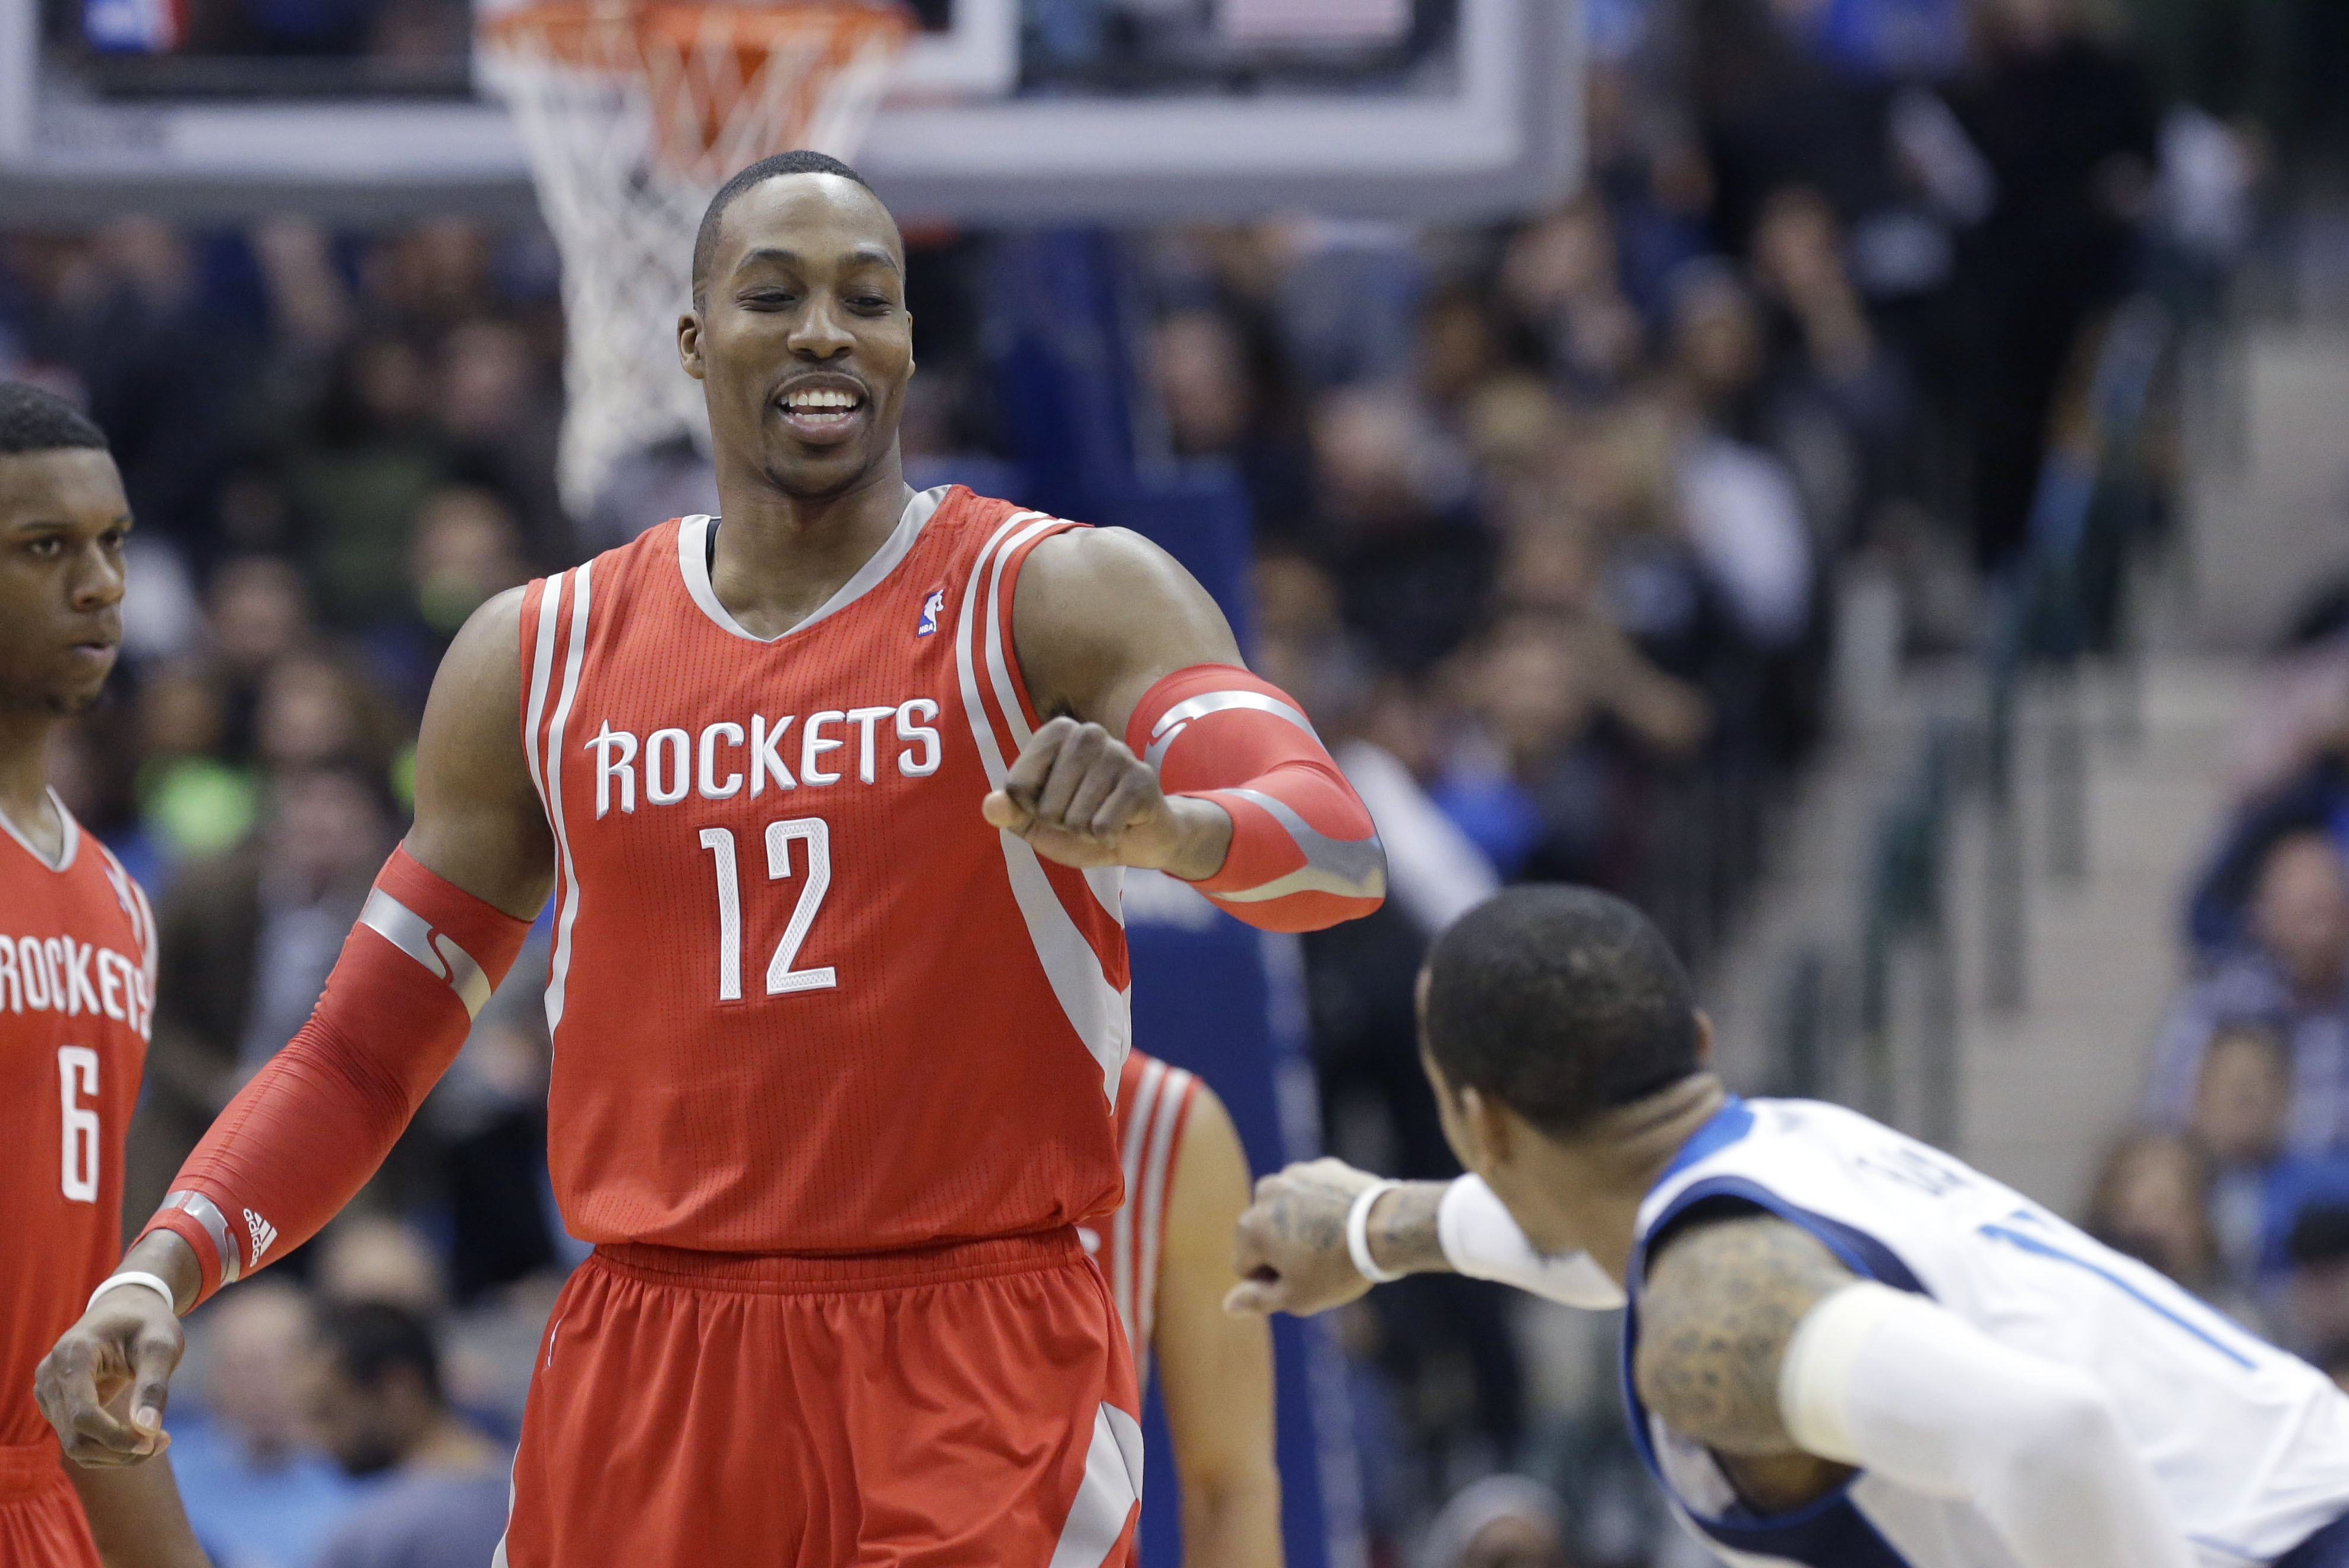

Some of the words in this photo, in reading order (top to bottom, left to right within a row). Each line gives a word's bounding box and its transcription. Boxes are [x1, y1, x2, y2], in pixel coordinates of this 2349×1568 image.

[918, 622, 933, 635] NBA
[583, 698, 942, 821] ROCKETS
[699, 817, 837, 1001] 12
[58, 1045, 100, 1204] 6
[242, 1207, 262, 1268] adidas
